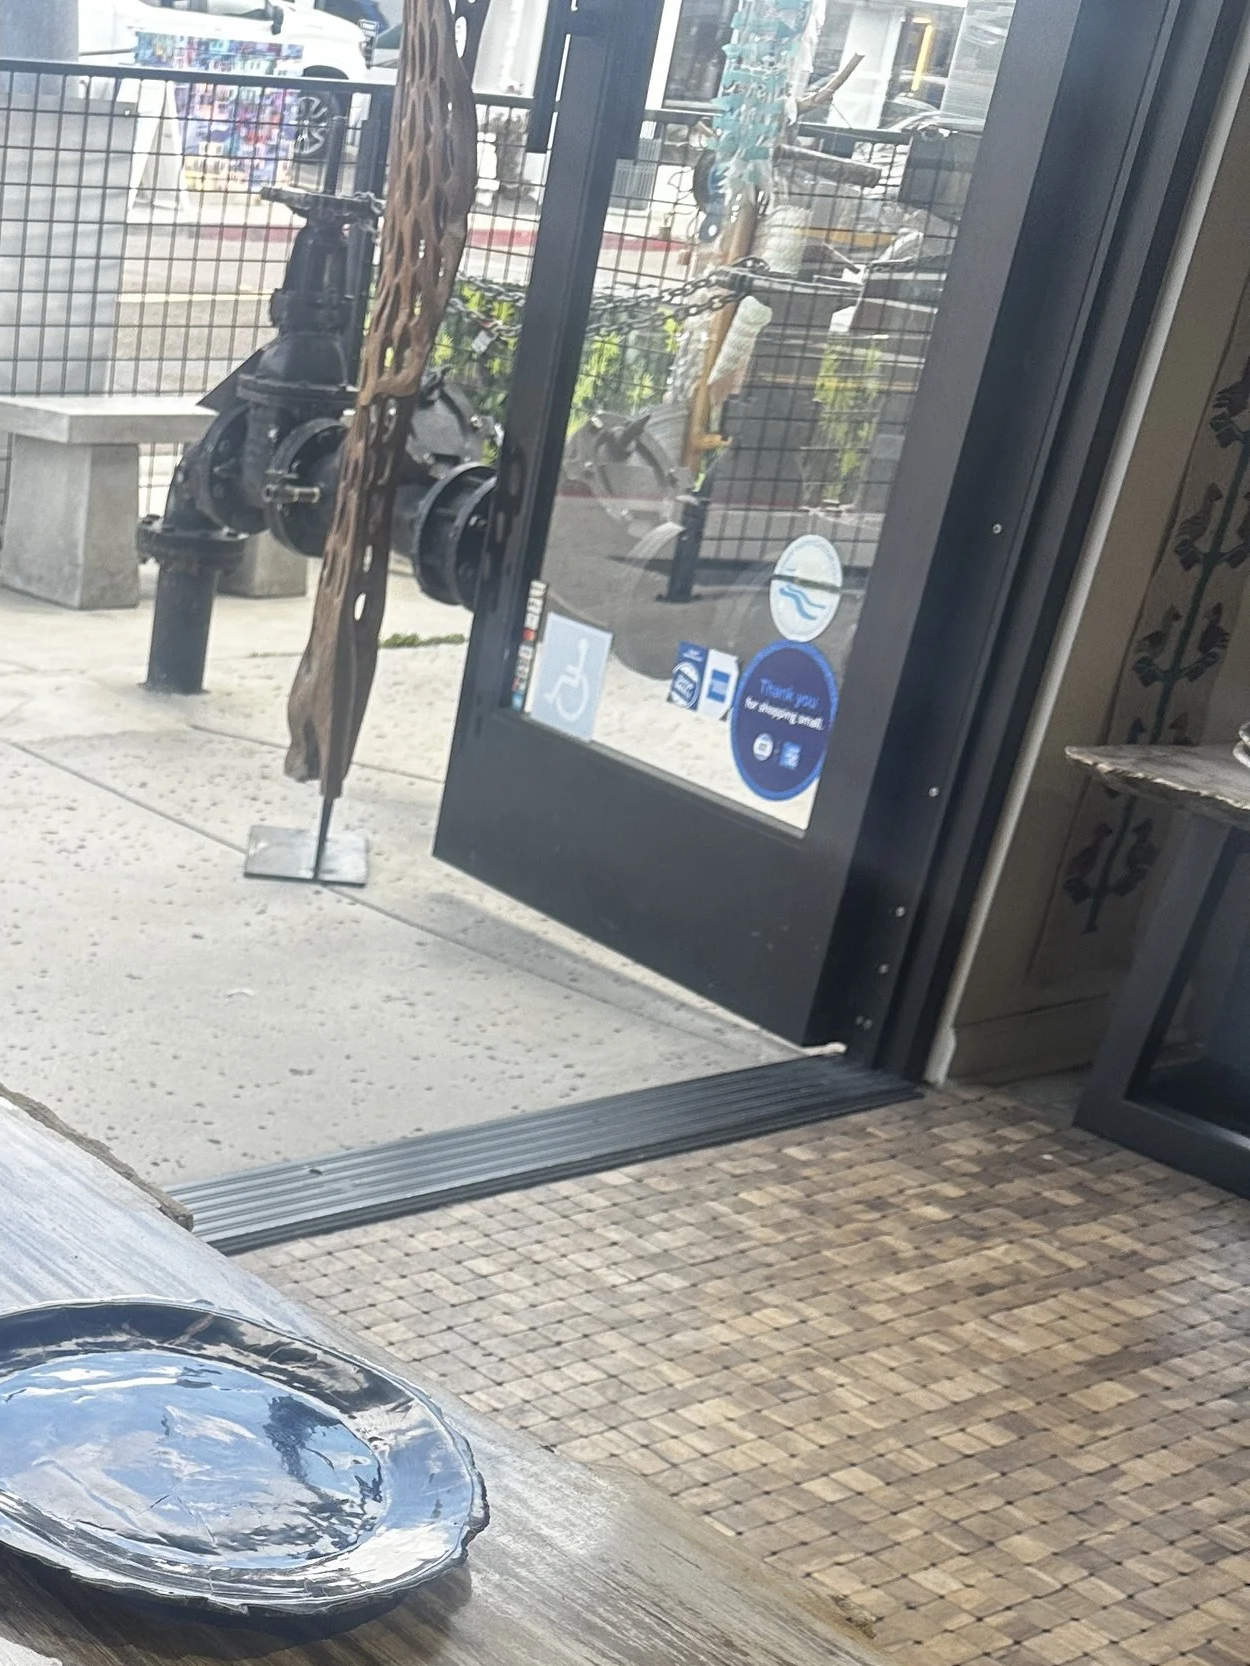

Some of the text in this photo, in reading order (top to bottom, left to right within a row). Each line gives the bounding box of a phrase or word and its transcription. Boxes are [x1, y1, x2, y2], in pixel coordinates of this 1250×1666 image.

[760, 678, 819, 708] Thank you
[744, 695, 758, 710] for
[758, 701, 797, 725] shopping
